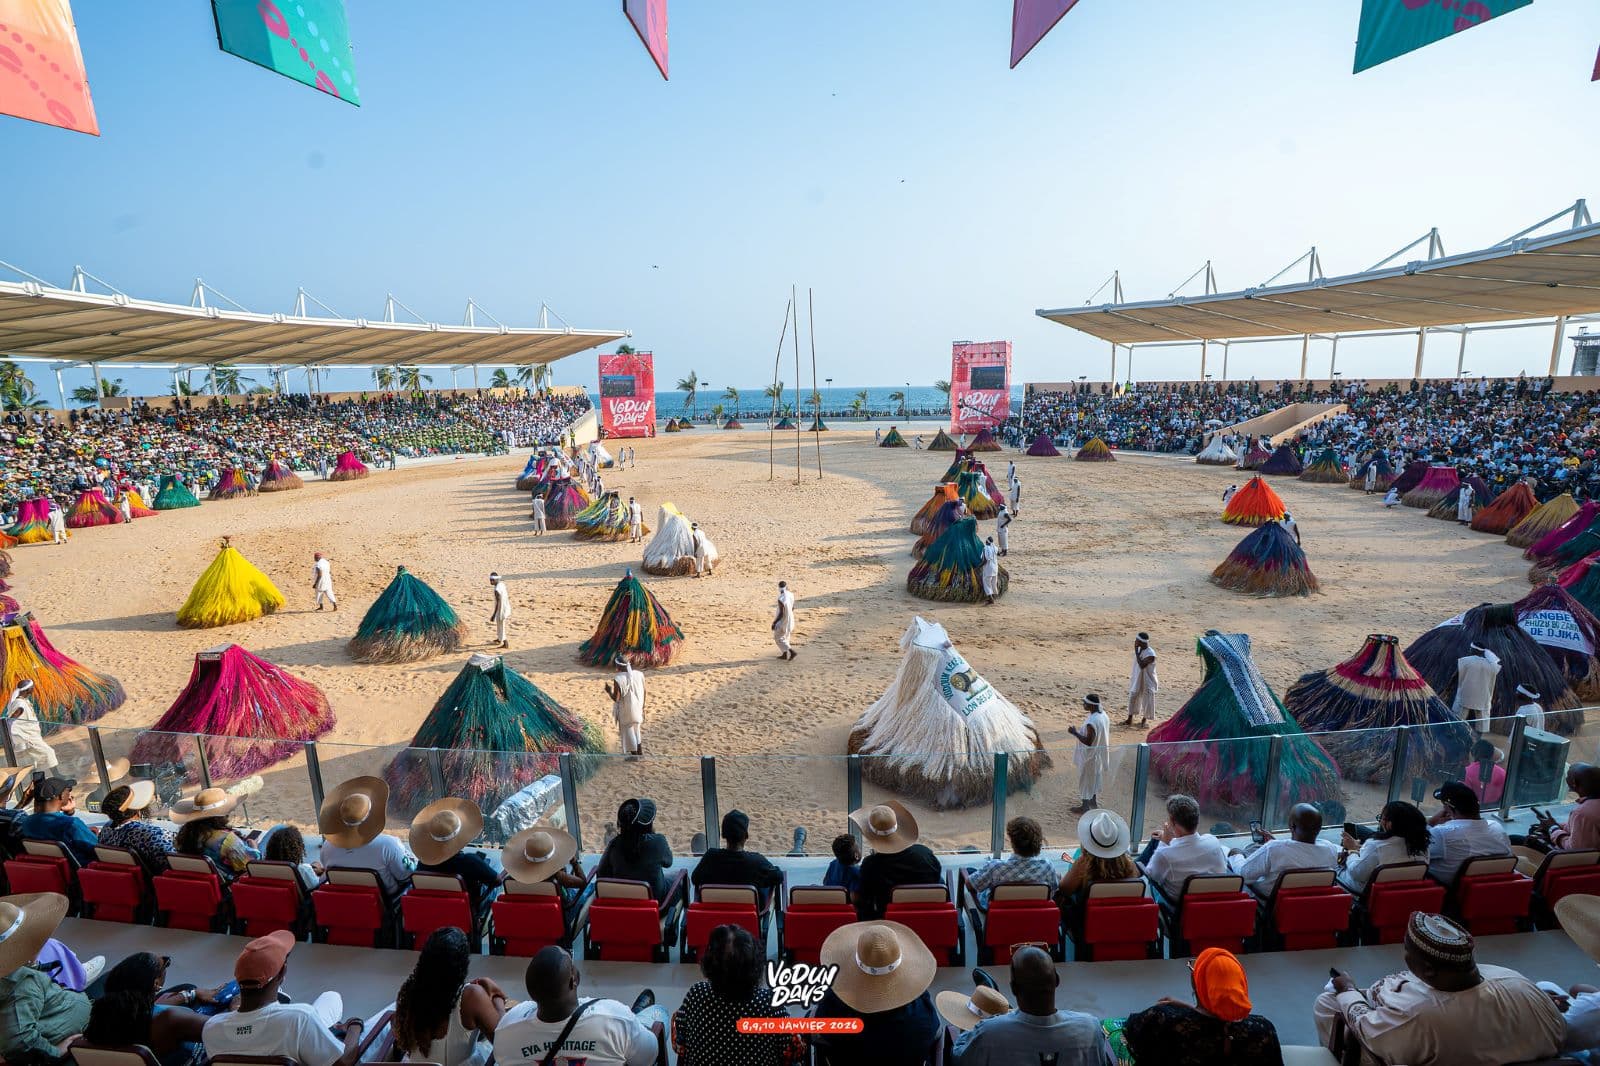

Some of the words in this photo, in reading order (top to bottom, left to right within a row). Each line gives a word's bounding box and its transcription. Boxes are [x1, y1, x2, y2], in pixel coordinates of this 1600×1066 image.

[1530, 628, 1543, 636] DE
[1547, 629, 1581, 641] DJIKA
[962, 701, 978, 716] LION
[521, 1044, 542, 1057] EYA
